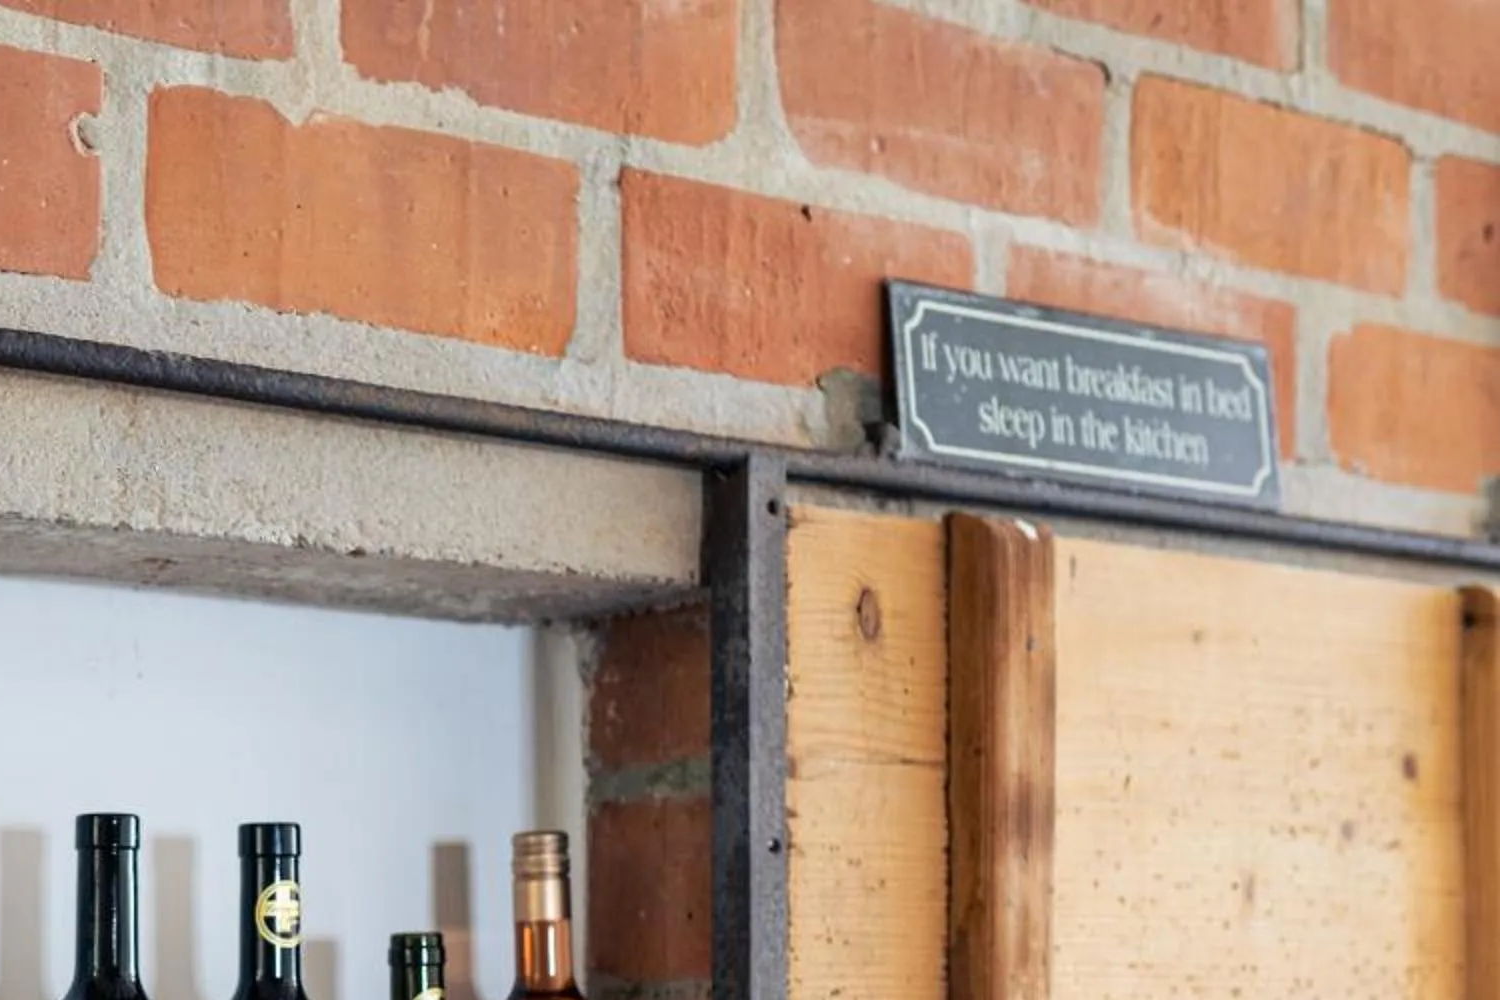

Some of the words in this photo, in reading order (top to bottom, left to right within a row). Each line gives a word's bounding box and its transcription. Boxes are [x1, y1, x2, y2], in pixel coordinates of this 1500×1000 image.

[920, 330, 938, 372] If
[942, 342, 993, 384] you
[998, 350, 1061, 392] want
[1065, 352, 1175, 410] breakfast
[1178, 372, 1203, 415] in
[1206, 376, 1253, 423] bed
[978, 396, 1047, 450] sleep
[1051, 405, 1076, 447] in
[1080, 409, 1121, 453] the
[1124, 414, 1210, 468] kitchen
